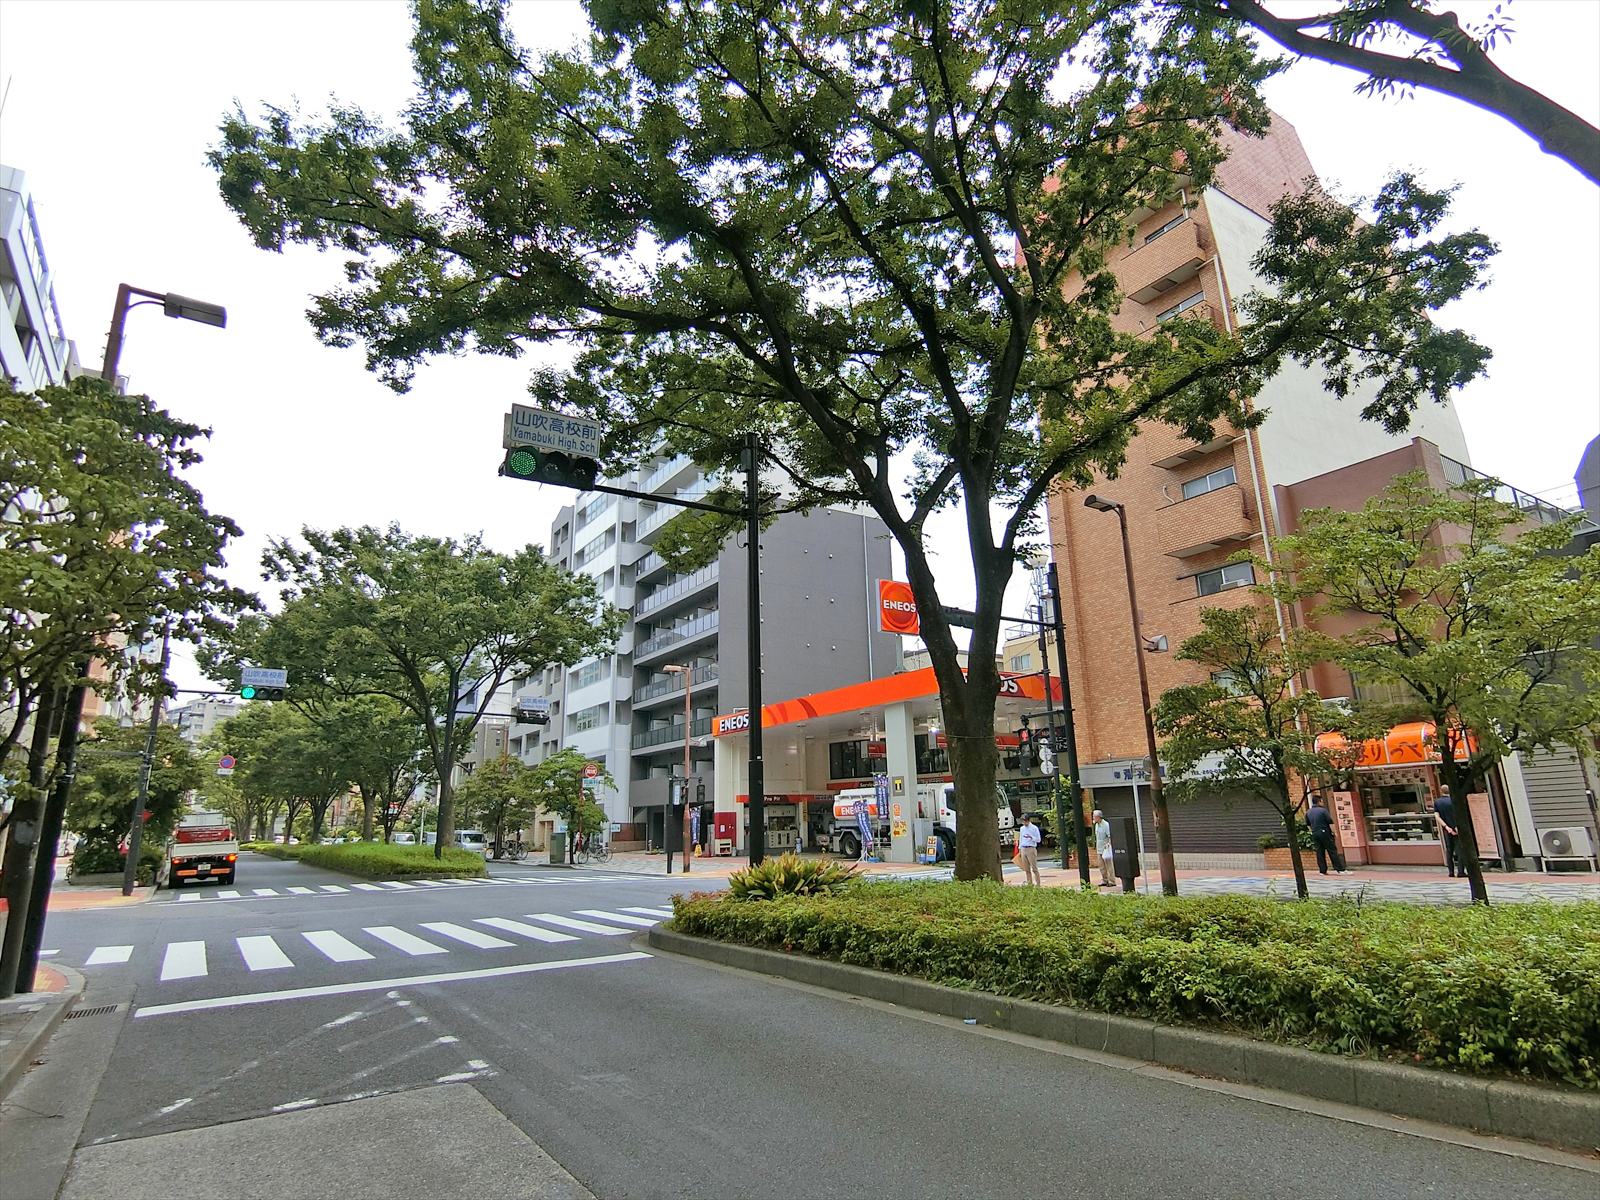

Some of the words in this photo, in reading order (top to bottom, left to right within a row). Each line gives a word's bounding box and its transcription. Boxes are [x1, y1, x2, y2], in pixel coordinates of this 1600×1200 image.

[515, 410, 597, 441] 山吹高校前
[513, 426, 556, 444] Yamabuki
[580, 441, 597, 454] Sch.
[883, 599, 917, 613] ENEOS
[719, 713, 749, 732] ENEOS
